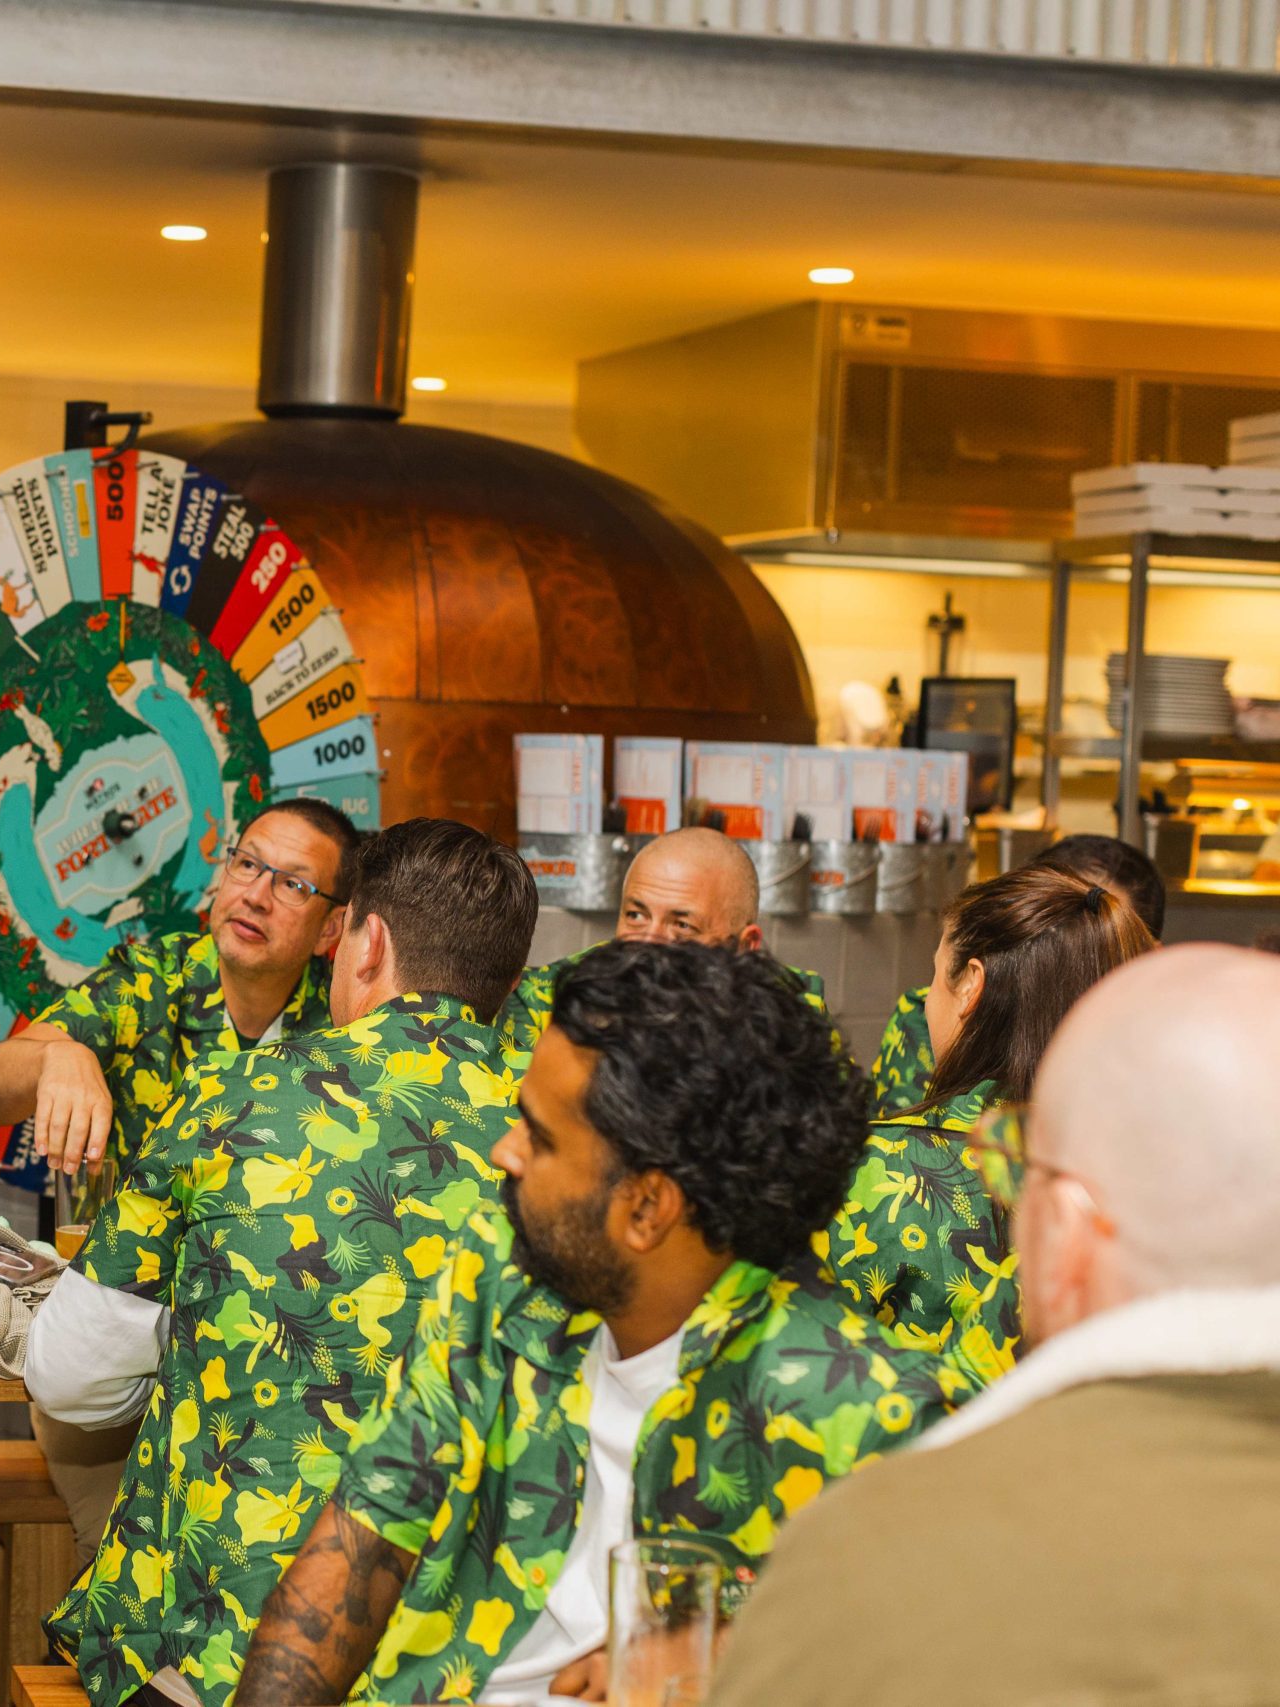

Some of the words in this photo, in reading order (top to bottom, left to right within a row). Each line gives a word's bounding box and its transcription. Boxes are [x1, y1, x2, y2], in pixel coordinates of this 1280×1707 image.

[107, 461, 124, 521] 500
[150, 463, 164, 482] A
[26, 478, 58, 557] POINTS
[141, 488, 160, 535] TELL
[156, 477, 176, 533] JOKE
[178, 488, 201, 546] SWAP
[189, 487, 217, 560] POINTS
[212, 504, 246, 559] STEAL
[230, 521, 254, 561] 500
[251, 541, 287, 594] 250
[270, 583, 315, 636] 1500
[295, 668, 311, 683] TO
[306, 682, 355, 720] 1500
[314, 734, 365, 767] 1000
